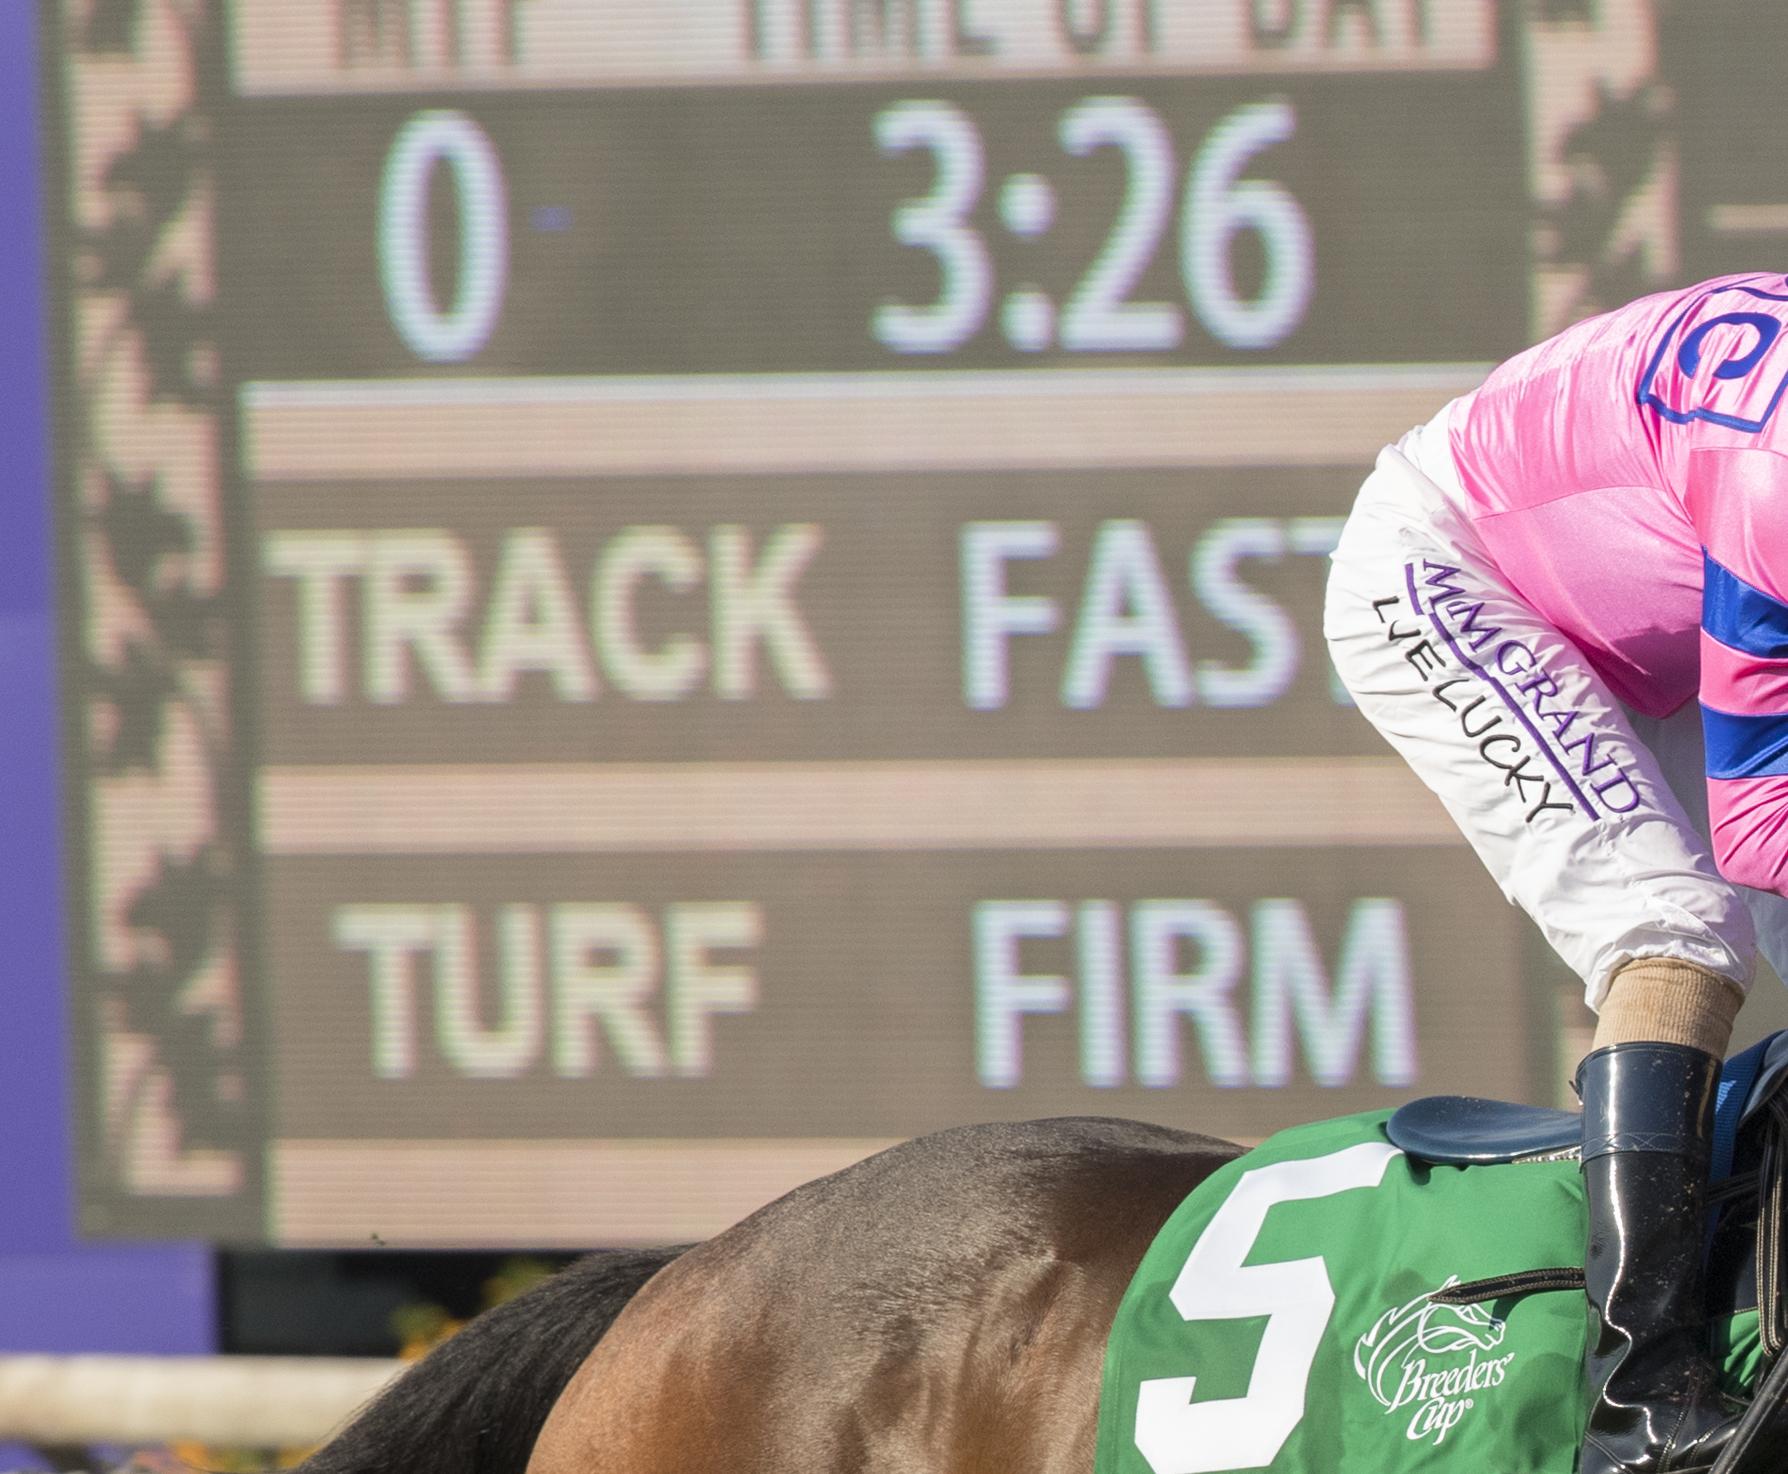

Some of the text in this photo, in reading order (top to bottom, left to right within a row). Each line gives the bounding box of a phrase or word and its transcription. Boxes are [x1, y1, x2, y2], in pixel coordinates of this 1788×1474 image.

[378, 109, 507, 362] 0
[872, 97, 1313, 356] 3:26
[263, 524, 833, 705] TRACK
[1432, 678, 1575, 824] LUCKY
[1493, 639, 1641, 815] GRAND
[332, 895, 1417, 1089] TURF FIRM
[1406, 1396, 1465, 1446] Cup
